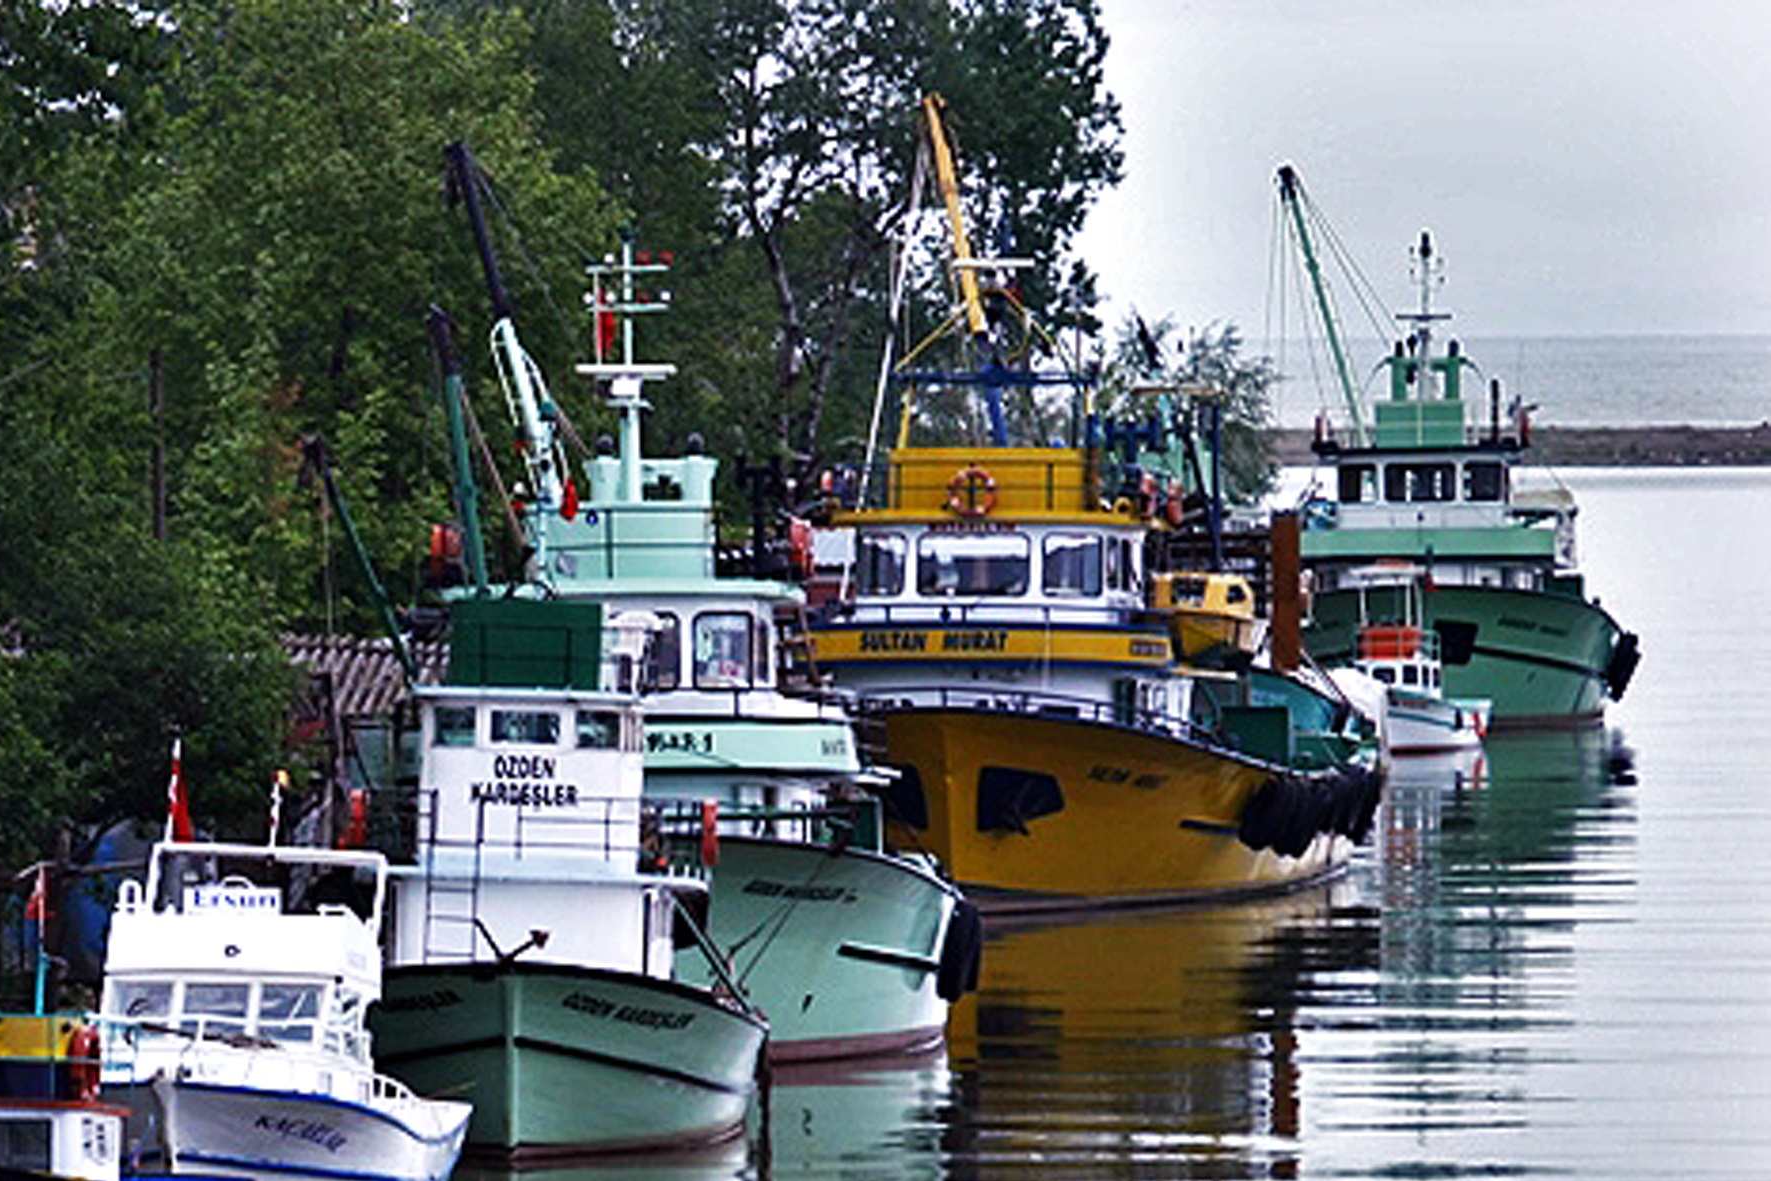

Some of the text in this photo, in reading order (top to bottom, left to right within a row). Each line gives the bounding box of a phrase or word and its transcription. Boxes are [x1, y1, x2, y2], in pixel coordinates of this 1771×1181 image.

[860, 631, 1008, 651] SULTAN MURAT
[194, 886, 276, 908] Ersun
